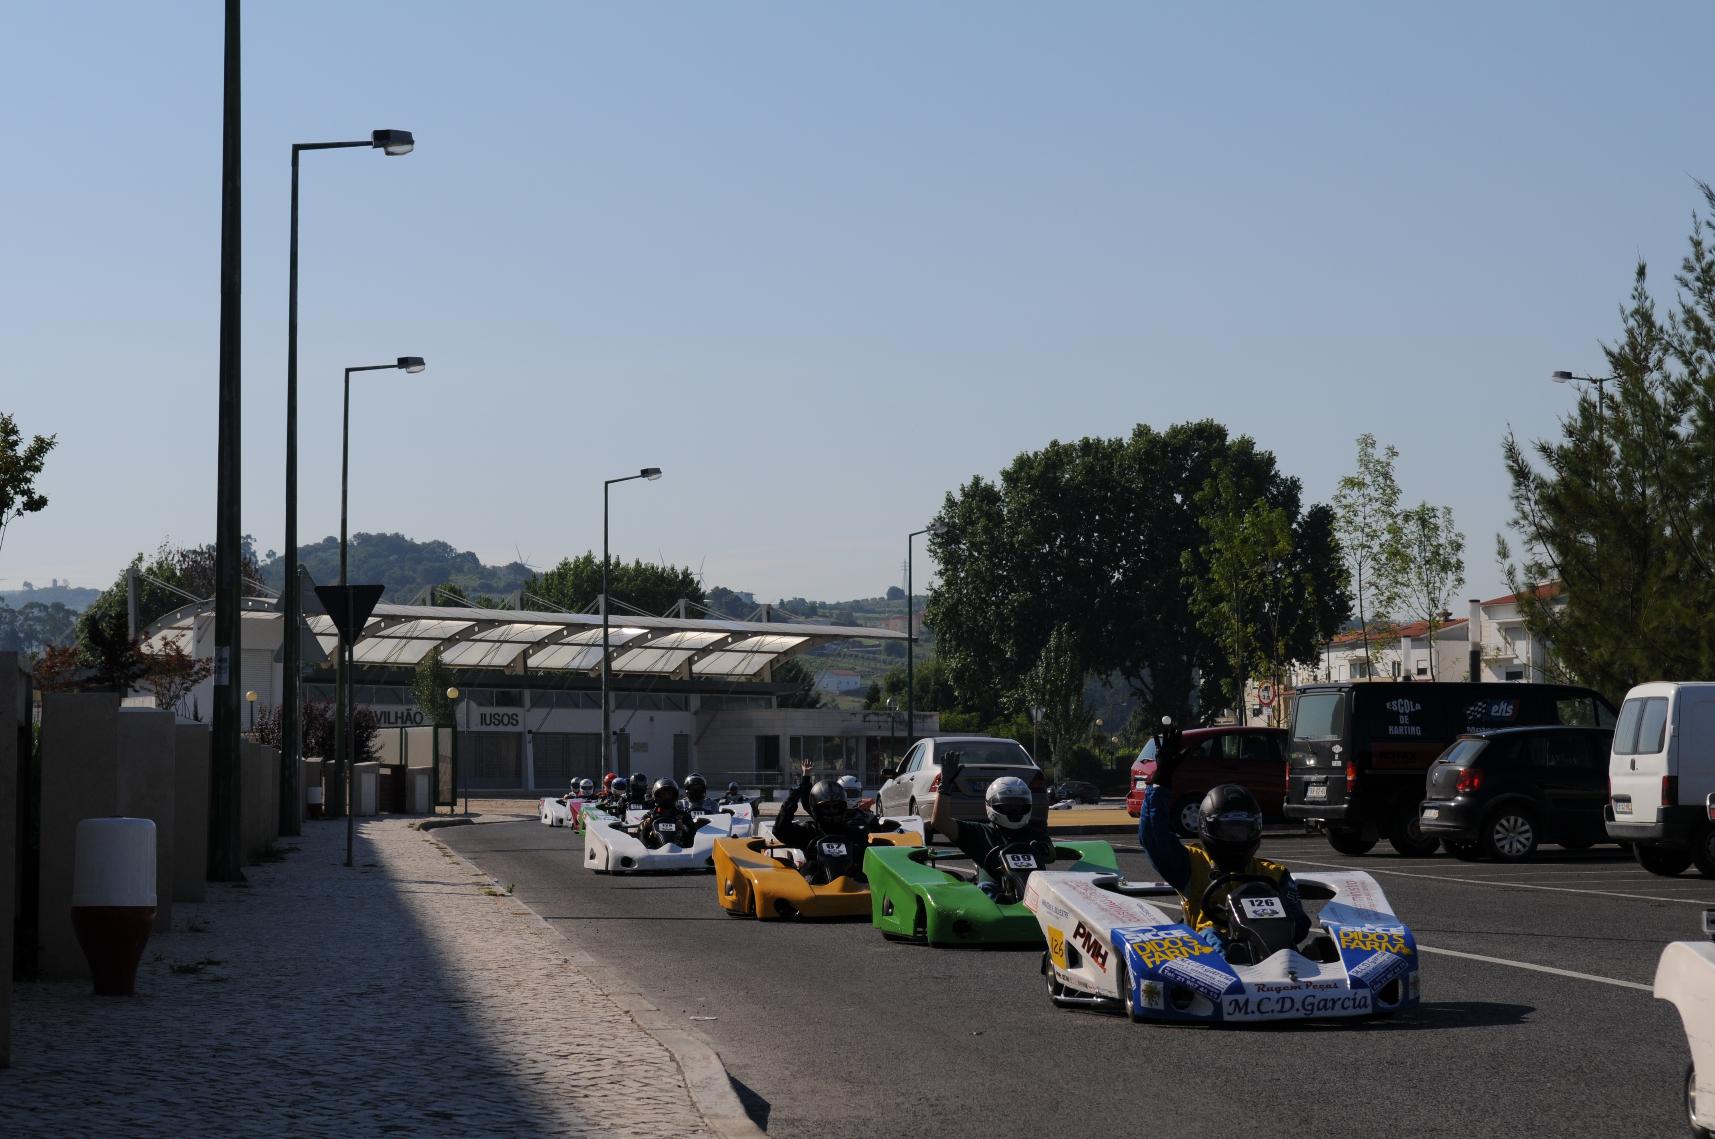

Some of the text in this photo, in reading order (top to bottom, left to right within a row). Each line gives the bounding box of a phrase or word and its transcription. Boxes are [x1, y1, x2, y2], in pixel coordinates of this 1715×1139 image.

[1385, 698, 1422, 713] ESCOLA
[1399, 715, 1409, 725] DE
[1388, 726, 1422, 736] KARTING
[1248, 898, 1274, 907] 126
[1339, 931, 1405, 944] DIDO'S
[1073, 921, 1109, 969] PMH
[1132, 935, 1199, 955] DIDO'S
[1341, 939, 1405, 953] FARM
[1141, 945, 1207, 968] FARM
